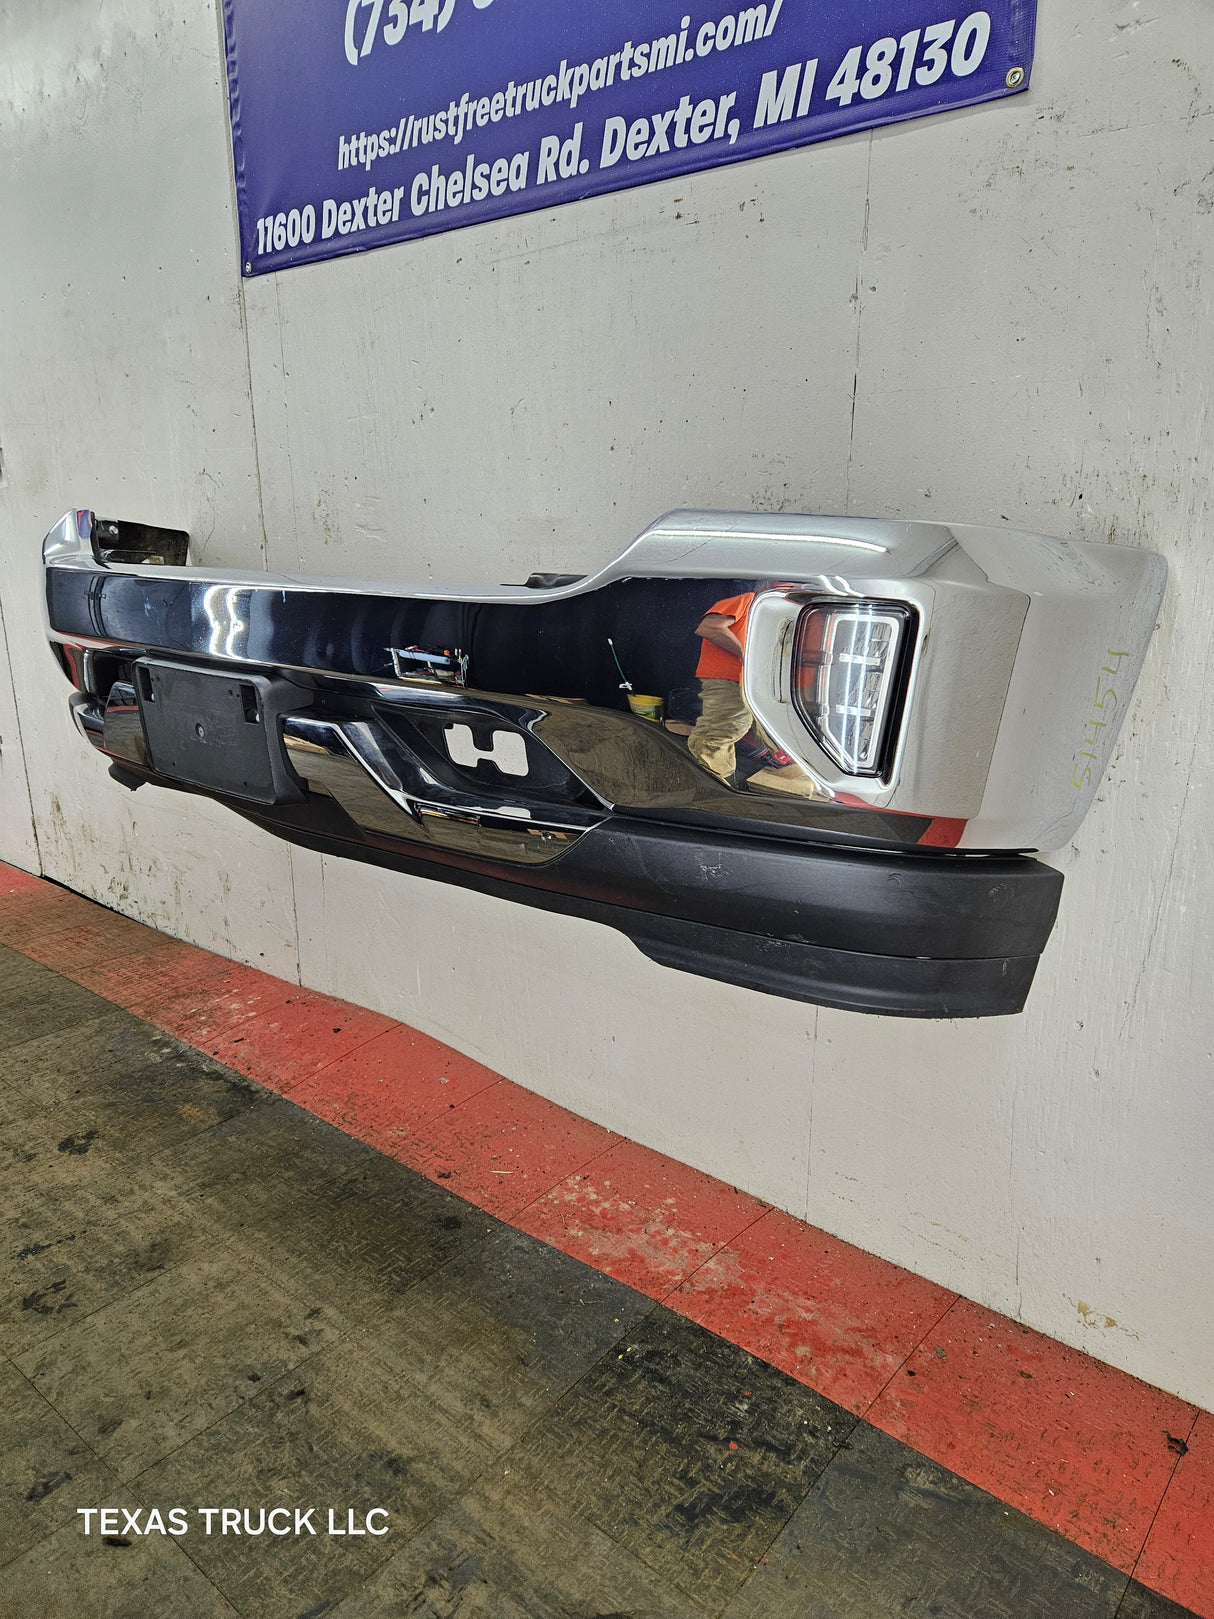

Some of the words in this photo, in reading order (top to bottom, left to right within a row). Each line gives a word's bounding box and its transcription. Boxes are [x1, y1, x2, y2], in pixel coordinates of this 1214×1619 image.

[257, 204, 316, 255] 11600
[321, 185, 404, 240] Dexter
[410, 151, 530, 217] Chelsea
[537, 122, 590, 189] Rd.
[600, 91, 737, 169] Dexter,
[753, 58, 819, 129] MI
[825, 11, 991, 106] 48130
[338, 0, 782, 171] https://rustfreetruckpartsmi.com/
